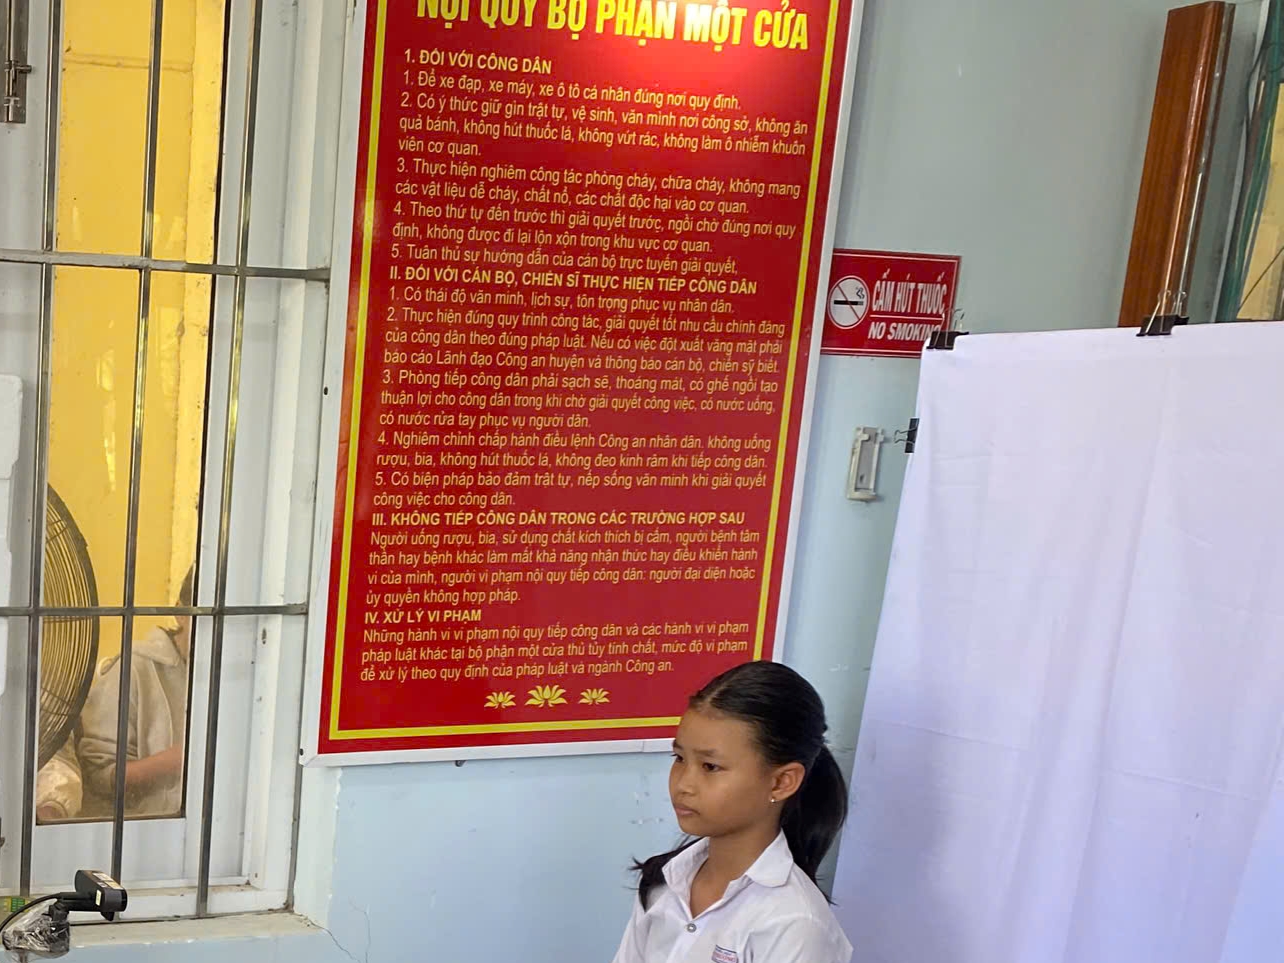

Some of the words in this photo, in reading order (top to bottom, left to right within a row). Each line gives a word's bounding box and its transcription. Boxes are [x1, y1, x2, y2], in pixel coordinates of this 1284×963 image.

[480, 0, 536, 29] QUY
[683, 0, 747, 51] MỘT
[753, 0, 808, 50] CỬA
[448, 49, 473, 68] VỚI
[476, 52, 518, 71] CÔNG
[521, 55, 551, 74] DÂN
[417, 67, 436, 87] Để
[439, 76, 454, 88] xe
[457, 74, 484, 94] đạp,
[488, 80, 504, 92] xe
[506, 79, 534, 98] máy,
[538, 84, 554, 96] xe
[556, 81, 565, 97] ô
[568, 82, 580, 98] tô
[600, 85, 631, 102] nhân
[633, 88, 664, 108] đúng
[666, 91, 686, 106] nơi
[688, 95, 711, 111] quy
[396, 156, 408, 173] 3.
[413, 157, 446, 177] Thực
[449, 160, 477, 179] hiện
[479, 163, 526, 183] nghiêm
[529, 166, 560, 186] công
[563, 168, 582, 184] tác
[584, 169, 623, 190] phòng
[626, 172, 657, 191] cháy,
[660, 174, 692, 190] chữa
[694, 176, 725, 195] cháy,
[728, 178, 765, 197] không
[767, 183, 801, 199] mang
[395, 179, 418, 195] các
[421, 180, 441, 198] vật
[443, 181, 466, 200] liệu
[469, 180, 485, 199] dễ
[488, 185, 519, 205] cháy,
[523, 184, 550, 203] chất
[552, 182, 571, 205] nổ,
[575, 190, 597, 205] các
[599, 185, 626, 207] chất
[628, 193, 650, 210] độc
[653, 194, 671, 212] hại
[698, 200, 715, 212] cơ
[717, 200, 748, 216] quan.
[392, 221, 422, 239] định,
[426, 223, 464, 244] không
[467, 225, 500, 244] được
[502, 228, 514, 242] đi
[517, 228, 531, 246] lại
[534, 229, 552, 246] lộn
[555, 230, 577, 248] xộn
[580, 232, 610, 251] trong
[613, 233, 634, 248] khu
[637, 238, 660, 252] vực
[662, 239, 679, 251] cơ
[680, 240, 712, 254] quan.
[389, 265, 401, 279] II.
[433, 264, 458, 282] VỚI
[461, 265, 491, 283] CÁN
[582, 274, 619, 292] THỰC
[688, 272, 726, 293] CÔNG
[729, 277, 757, 294] DÂN
[872, 269, 892, 312] CẤM
[894, 274, 916, 313] HÚT
[916, 271, 947, 315] THUỐC
[403, 285, 422, 301] Có
[425, 287, 447, 302] thái
[450, 288, 466, 305] độ
[469, 289, 491, 304] văn
[530, 291, 551, 308] lịch
[576, 293, 594, 308] tôn
[597, 295, 628, 313] trọng
[630, 296, 659, 313] phục
[662, 300, 676, 315] vụ
[678, 297, 707, 312] nhân
[710, 298, 734, 313] dân.
[868, 322, 886, 339] NO
[375, 471, 386, 486] 5.
[390, 471, 409, 486] Có
[412, 471, 439, 488] biện
[442, 471, 474, 489] pháp
[503, 471, 531, 486] đảm
[534, 472, 554, 486] trật
[577, 466, 600, 488] nếp
[603, 469, 633, 489] sống
[635, 472, 657, 486] văn
[659, 473, 688, 486] minh
[691, 473, 708, 486] khi
[710, 472, 732, 490] giải
[734, 467, 766, 490] quyết
[371, 512, 387, 525] III.
[390, 507, 440, 526] KHÔNG
[476, 506, 515, 525] CÔNG
[518, 509, 546, 525] DÂN
[549, 511, 596, 525] TRONG
[599, 509, 627, 524] CÁC
[630, 509, 685, 524] TRƯỜNG
[688, 511, 716, 526] HỢP
[718, 511, 745, 524] SAU
[383, 586, 420, 607] quyền
[423, 588, 459, 606] không
[462, 588, 486, 604] hợp
[488, 587, 520, 604] pháp.
[364, 611, 379, 624] IV.
[382, 605, 404, 623] XỬ
[406, 607, 424, 623] LÝ
[427, 610, 440, 622] VI
[443, 608, 481, 624] PHẠM
[359, 662, 375, 681] để
[378, 666, 395, 680] xử
[397, 666, 408, 683] lý
[410, 665, 437, 679] theo
[439, 668, 461, 681] quy
[463, 663, 489, 679] định
[491, 662, 513, 677] của
[515, 662, 545, 679] pháp
[547, 661, 568, 676] luật
[625, 658, 655, 675] Công
